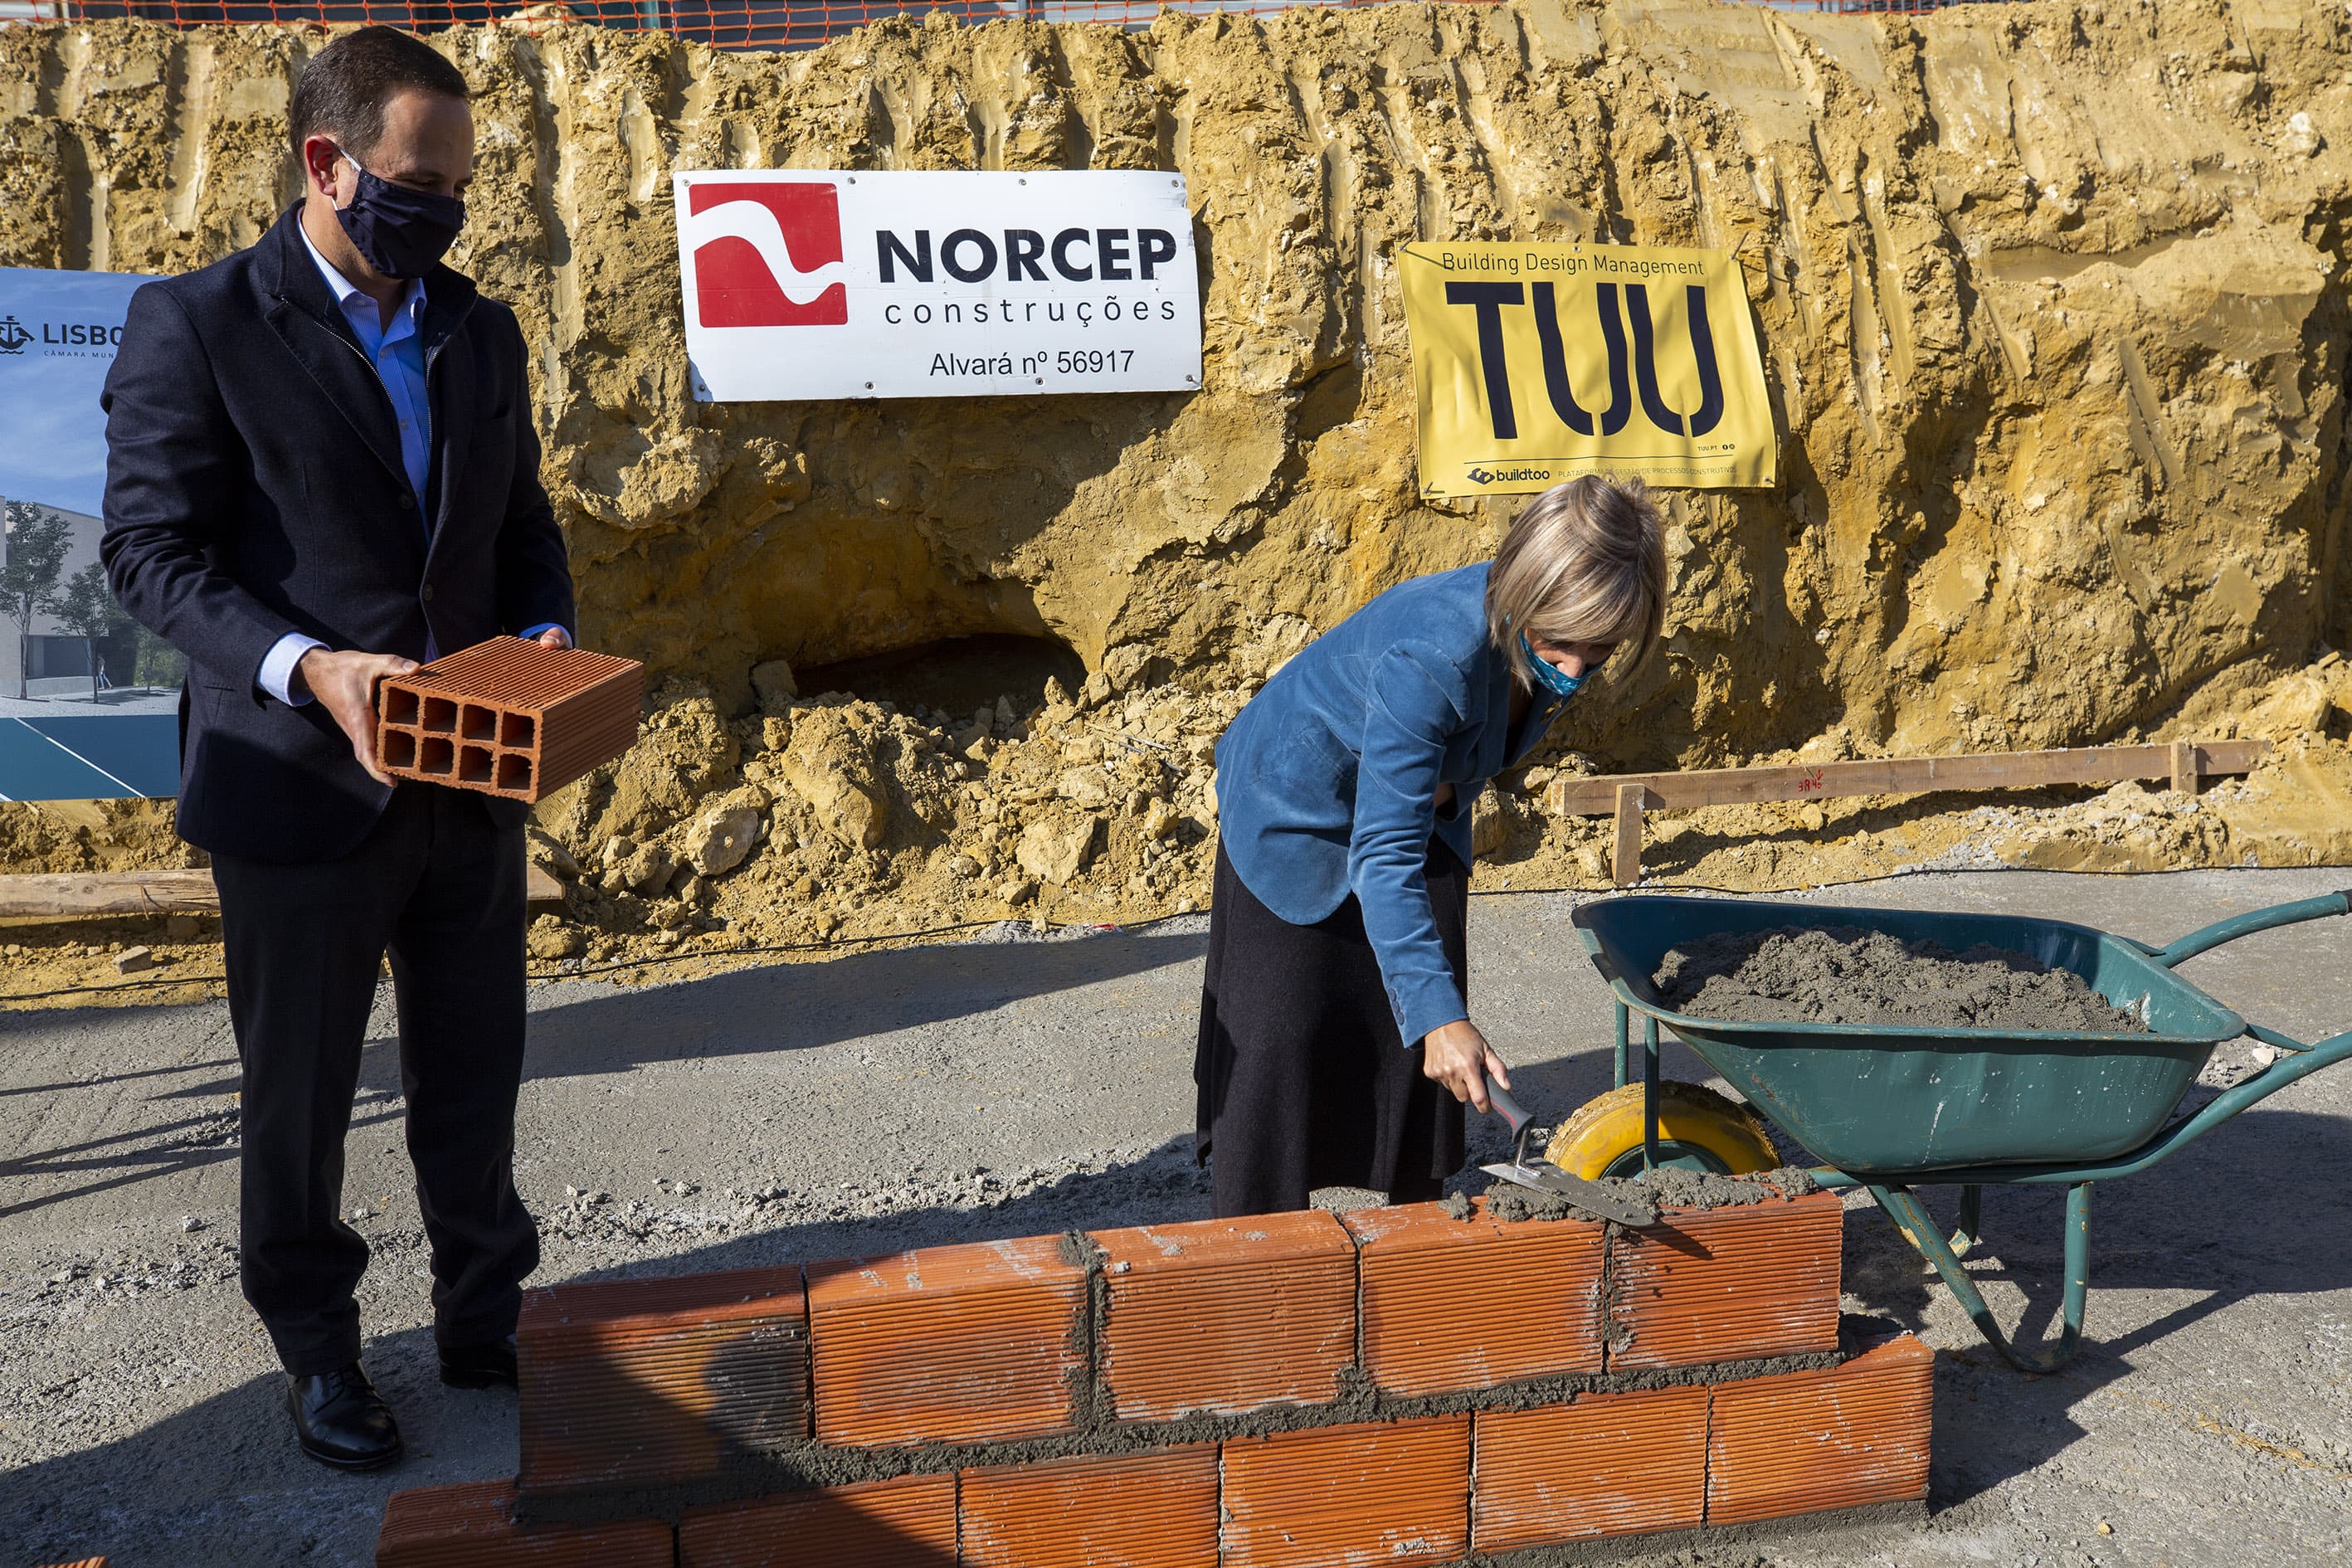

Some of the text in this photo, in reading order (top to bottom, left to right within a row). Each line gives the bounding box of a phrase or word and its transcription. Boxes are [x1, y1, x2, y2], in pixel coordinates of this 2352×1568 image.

[876, 227, 1177, 283] NORCEP
[1443, 252, 1705, 278] Building Design Management
[885, 294, 1176, 328] construções
[43, 323, 124, 347] LISBO
[930, 352, 1013, 377] Alvará
[1057, 350, 1134, 373] 56917
[1444, 281, 1725, 440] TUU
[1496, 469, 1551, 482] buildtoo
[1690, 465, 1737, 475] CONSTRUTIVOS
